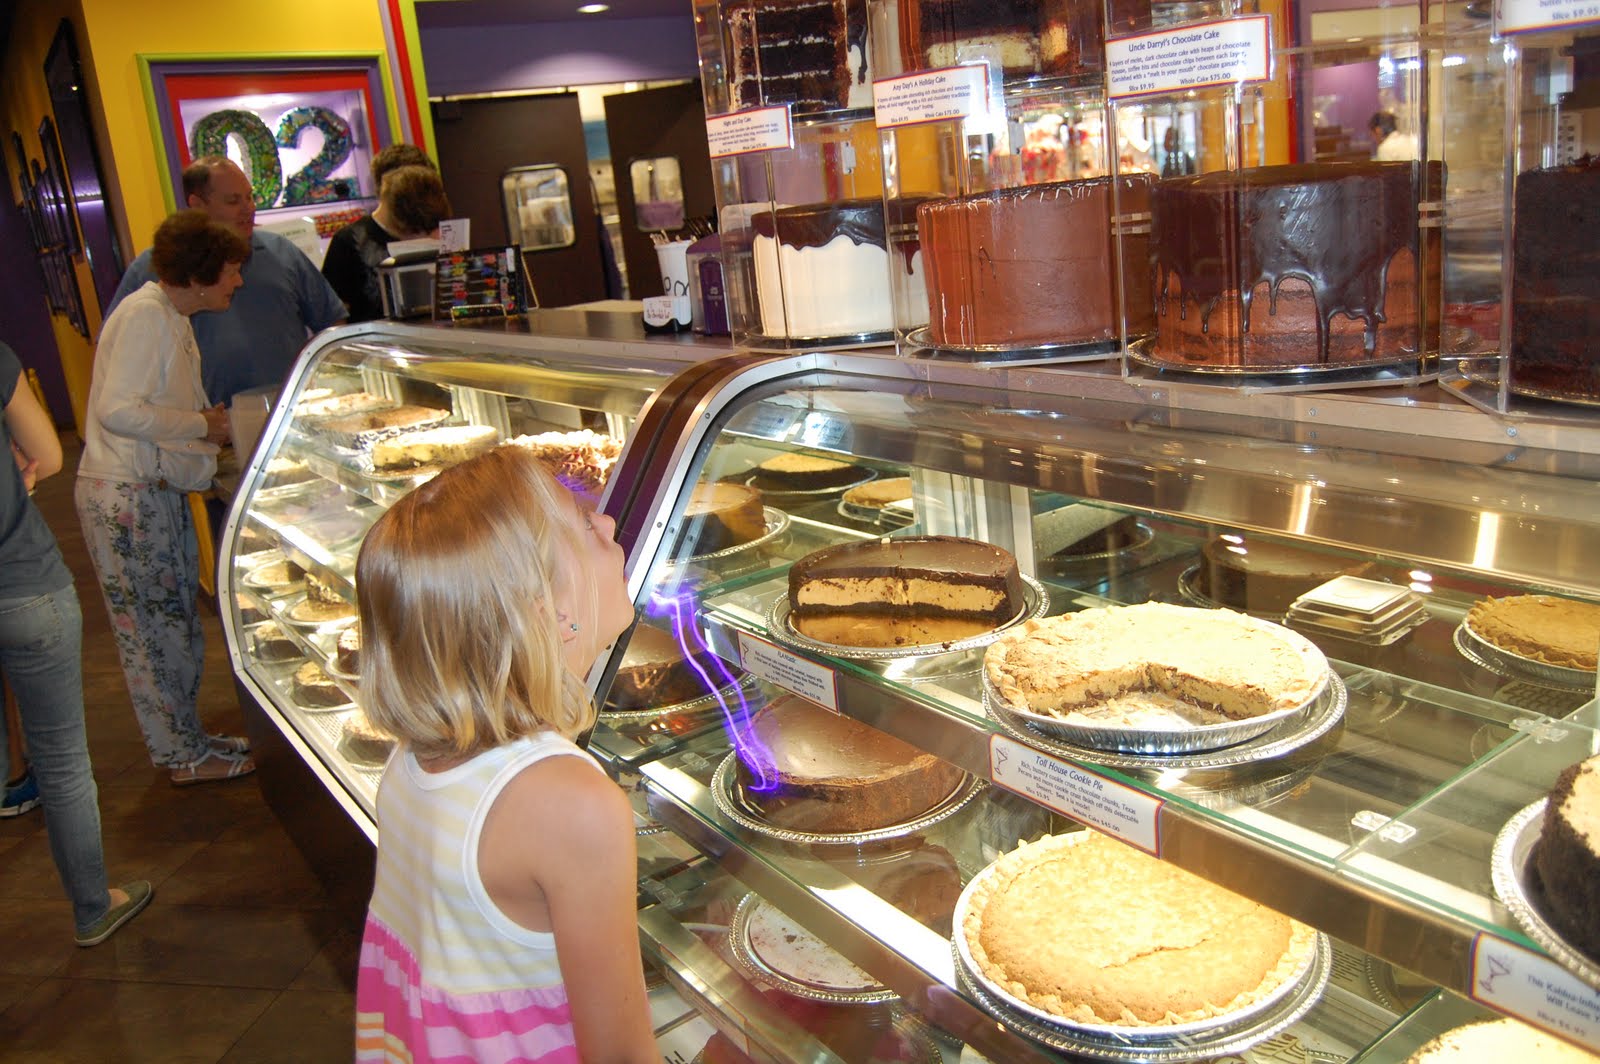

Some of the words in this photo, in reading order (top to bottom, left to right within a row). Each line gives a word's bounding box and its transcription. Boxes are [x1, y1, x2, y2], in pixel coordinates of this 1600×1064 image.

[1129, 43, 1145, 52] Uncle
[1147, 38, 1170, 48] Darryl's
[1171, 34, 1202, 44] Chocolate
[1203, 30, 1220, 39] Cake
[1156, 52, 1177, 60] chocolate
[1160, 60, 1181, 68] chocolate
[1196, 54, 1215, 62] between
[902, 81, 913, 89] Day's
[919, 78, 934, 86] Holiday
[1210, 72, 1231, 81] $75.00
[1036, 755, 1048, 767] Toll
[1049, 761, 1068, 776] House
[1069, 770, 1091, 786] Cookie
[1093, 780, 1103, 791] Pie
[1021, 760, 1031, 770] Rich,
[1032, 766, 1048, 777] buttery
[1049, 774, 1063, 783] cookie
[1065, 781, 1077, 790] crust,
[1078, 786, 1100, 800] chocolate
[1102, 796, 1120, 808] chunks,
[1122, 803, 1136, 814] Texas
[1018, 767, 1032, 777] Pecans
[1042, 779, 1053, 787] more
[1054, 785, 1069, 794] cookie
[1070, 791, 1081, 800] crust
[1082, 795, 1094, 805] finish
[1104, 805, 1112, 813] this
[1114, 810, 1139, 824] delectable
[1072, 807, 1087, 817] Whole
[1088, 814, 1099, 822] Cake
[1546, 993, 1562, 1007] Will
